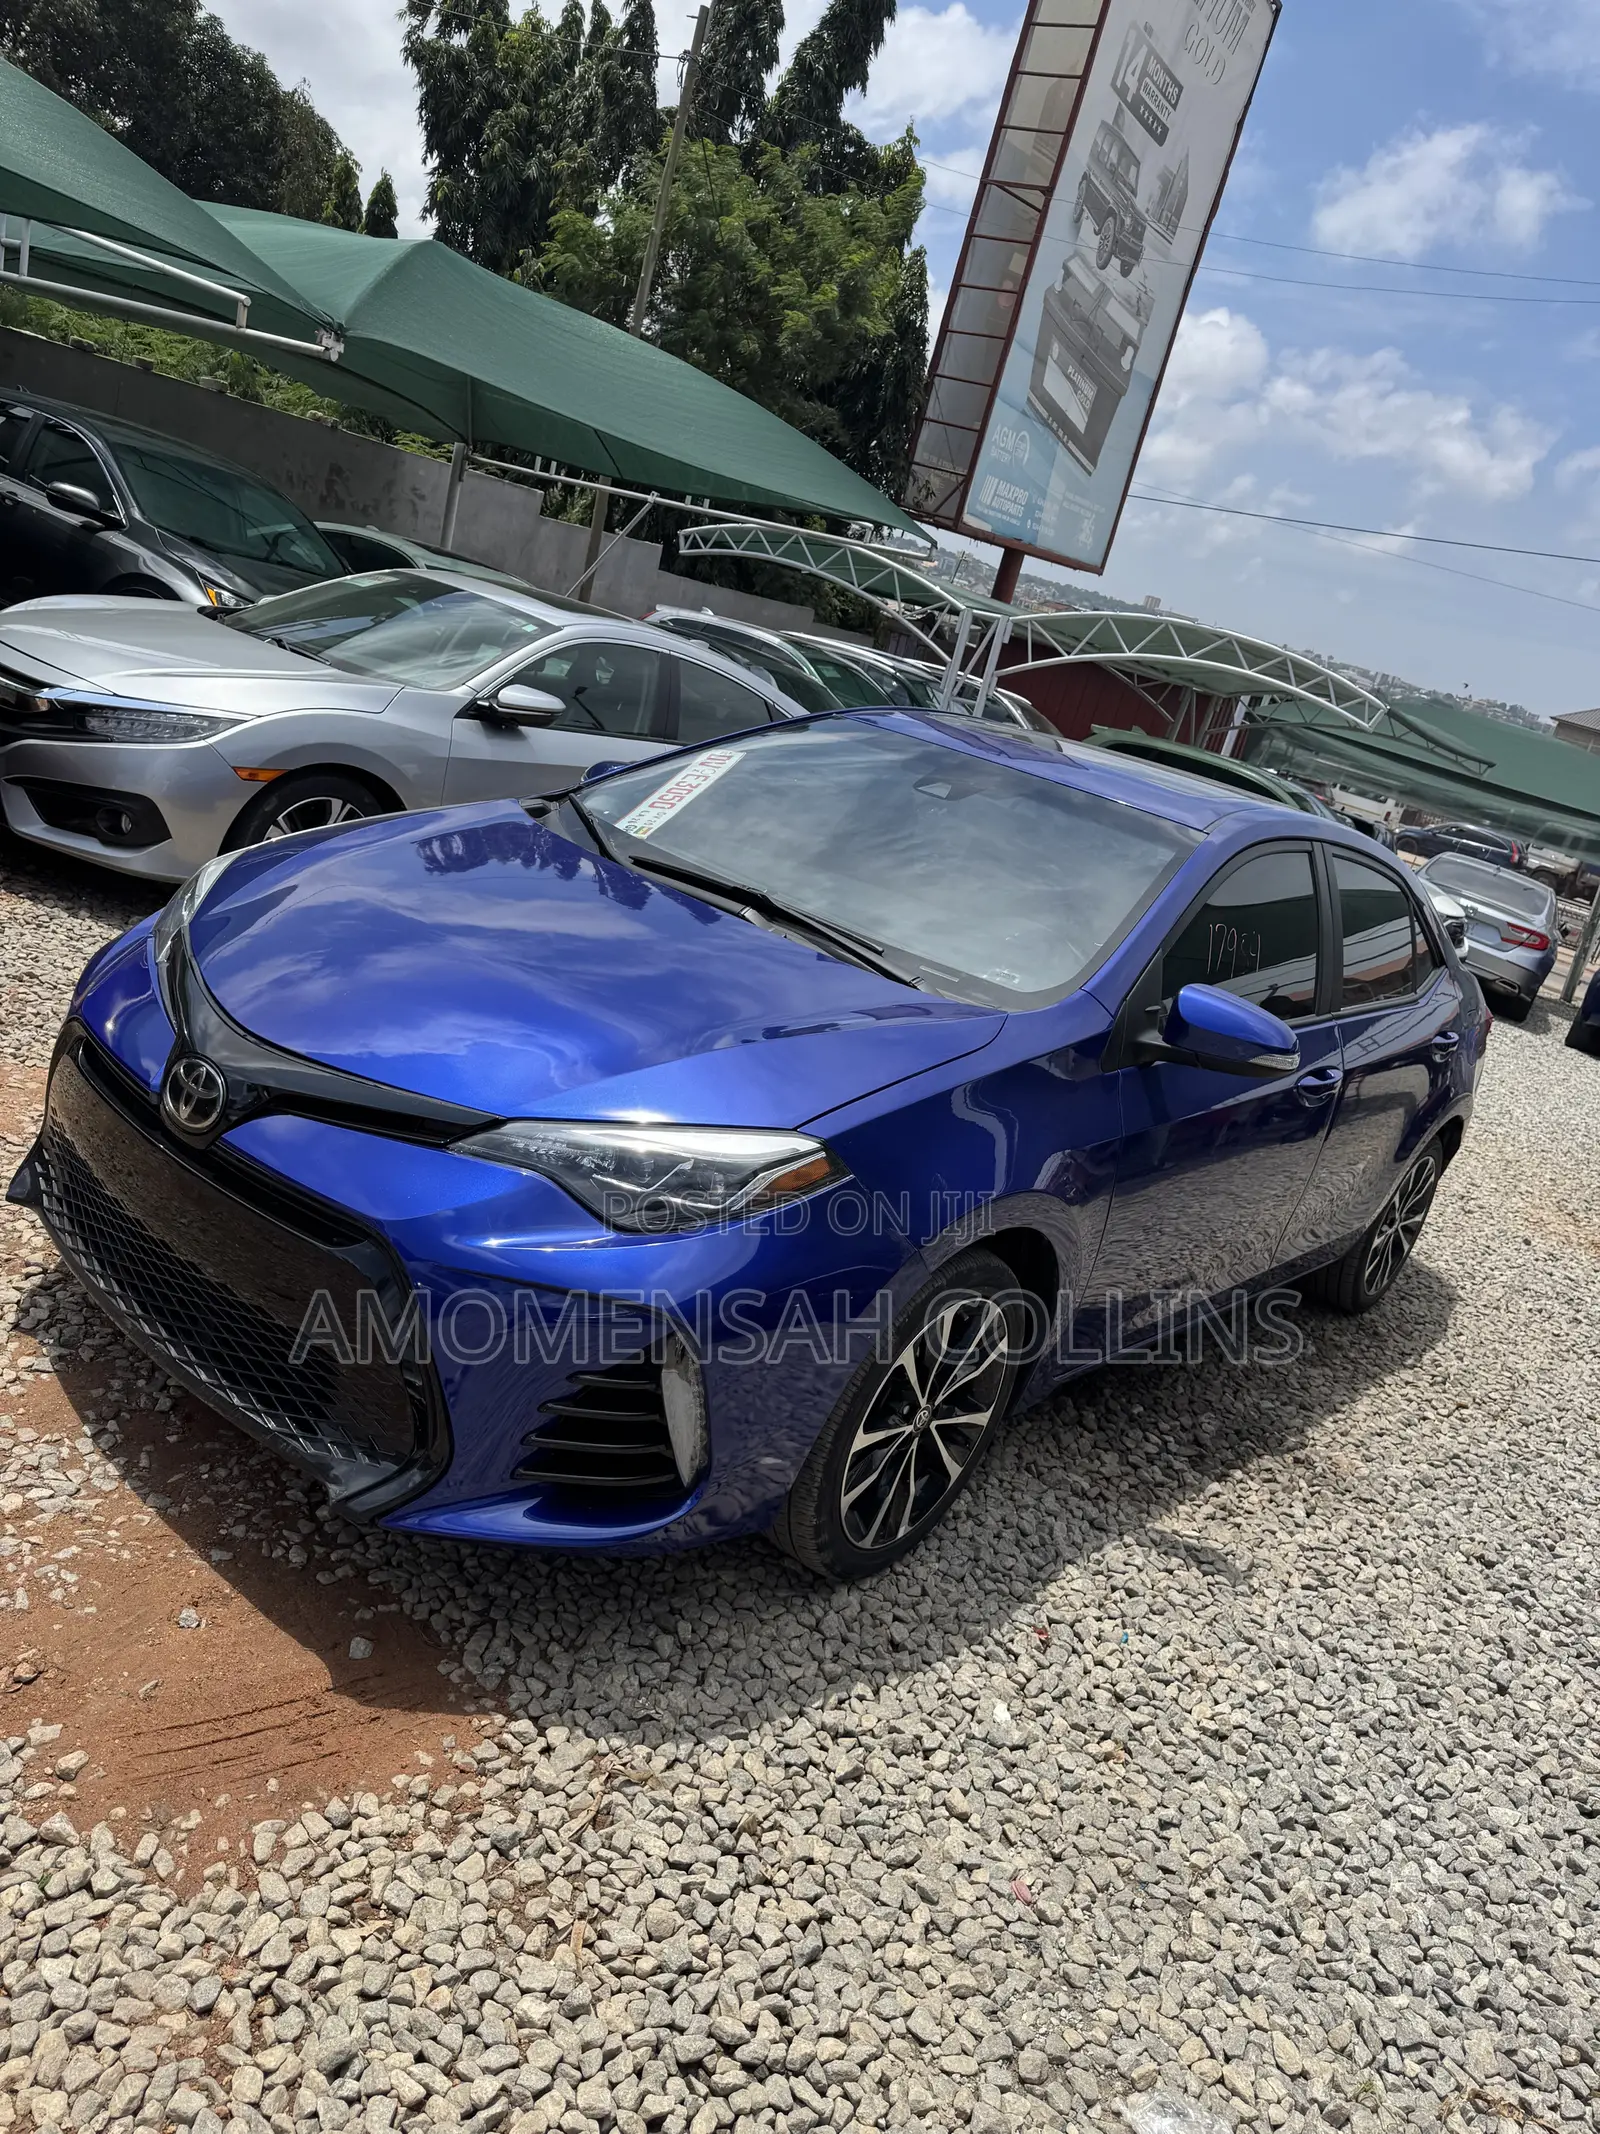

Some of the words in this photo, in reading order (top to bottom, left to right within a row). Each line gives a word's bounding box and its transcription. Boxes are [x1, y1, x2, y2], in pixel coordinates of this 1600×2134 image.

[1116, 28, 1148, 103] 14
[1184, 22, 1226, 85] GOLD
[1146, 55, 1179, 105] MONTHS
[1141, 82, 1172, 121] WARRANTY
[1067, 364, 1094, 401] PLATINUM
[1076, 390, 1091, 410] GOLD
[991, 423, 1017, 453] AGM
[990, 495, 1025, 518] AUTOPARTS
[996, 479, 1029, 506] MAXPRO
